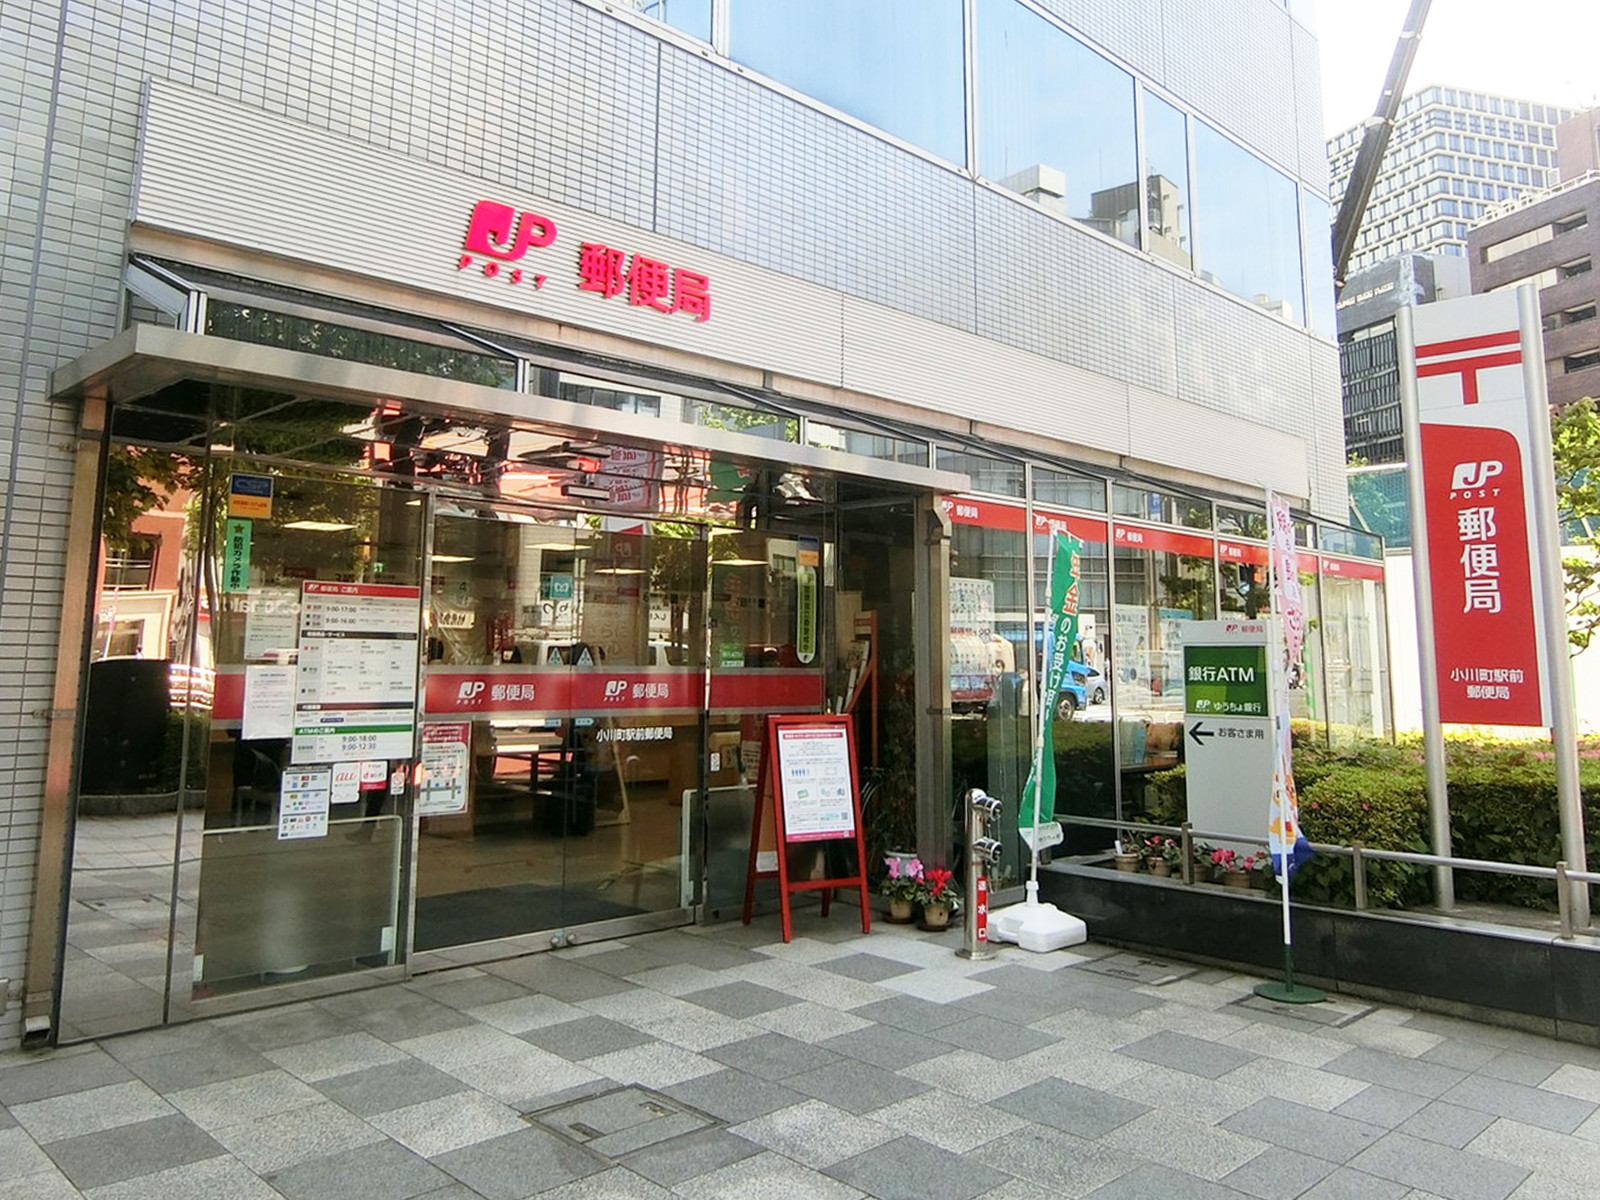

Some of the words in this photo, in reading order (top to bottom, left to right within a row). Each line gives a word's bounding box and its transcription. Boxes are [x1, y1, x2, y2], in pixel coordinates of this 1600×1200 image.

[465, 200, 557, 261] JP
[578, 241, 711, 322] 郵便局
[458, 254, 548, 289] POST
[1451, 460, 1503, 489] JP
[1450, 488, 1501, 499] POST
[956, 504, 979, 519] 郵便局
[230, 536, 244, 590] 防犯カメラ作動中
[1458, 507, 1502, 614] 郵便局
[1241, 624, 1264, 633] 郵便局
[1188, 665, 1255, 682] 銀行ATM
[1450, 667, 1525, 684] 小川町駅前
[458, 681, 486, 700] JP
[491, 684, 535, 701] 郵便局
[605, 680, 628, 697] JP
[632, 683, 669, 699] 郵便局
[1466, 685, 1510, 700] 郵便局
[1213, 701, 1262, 713] ゆうちょ銀行
[596, 726, 673, 743] 小川町駅前郵便局
[1218, 727, 1265, 740] お客さま用
